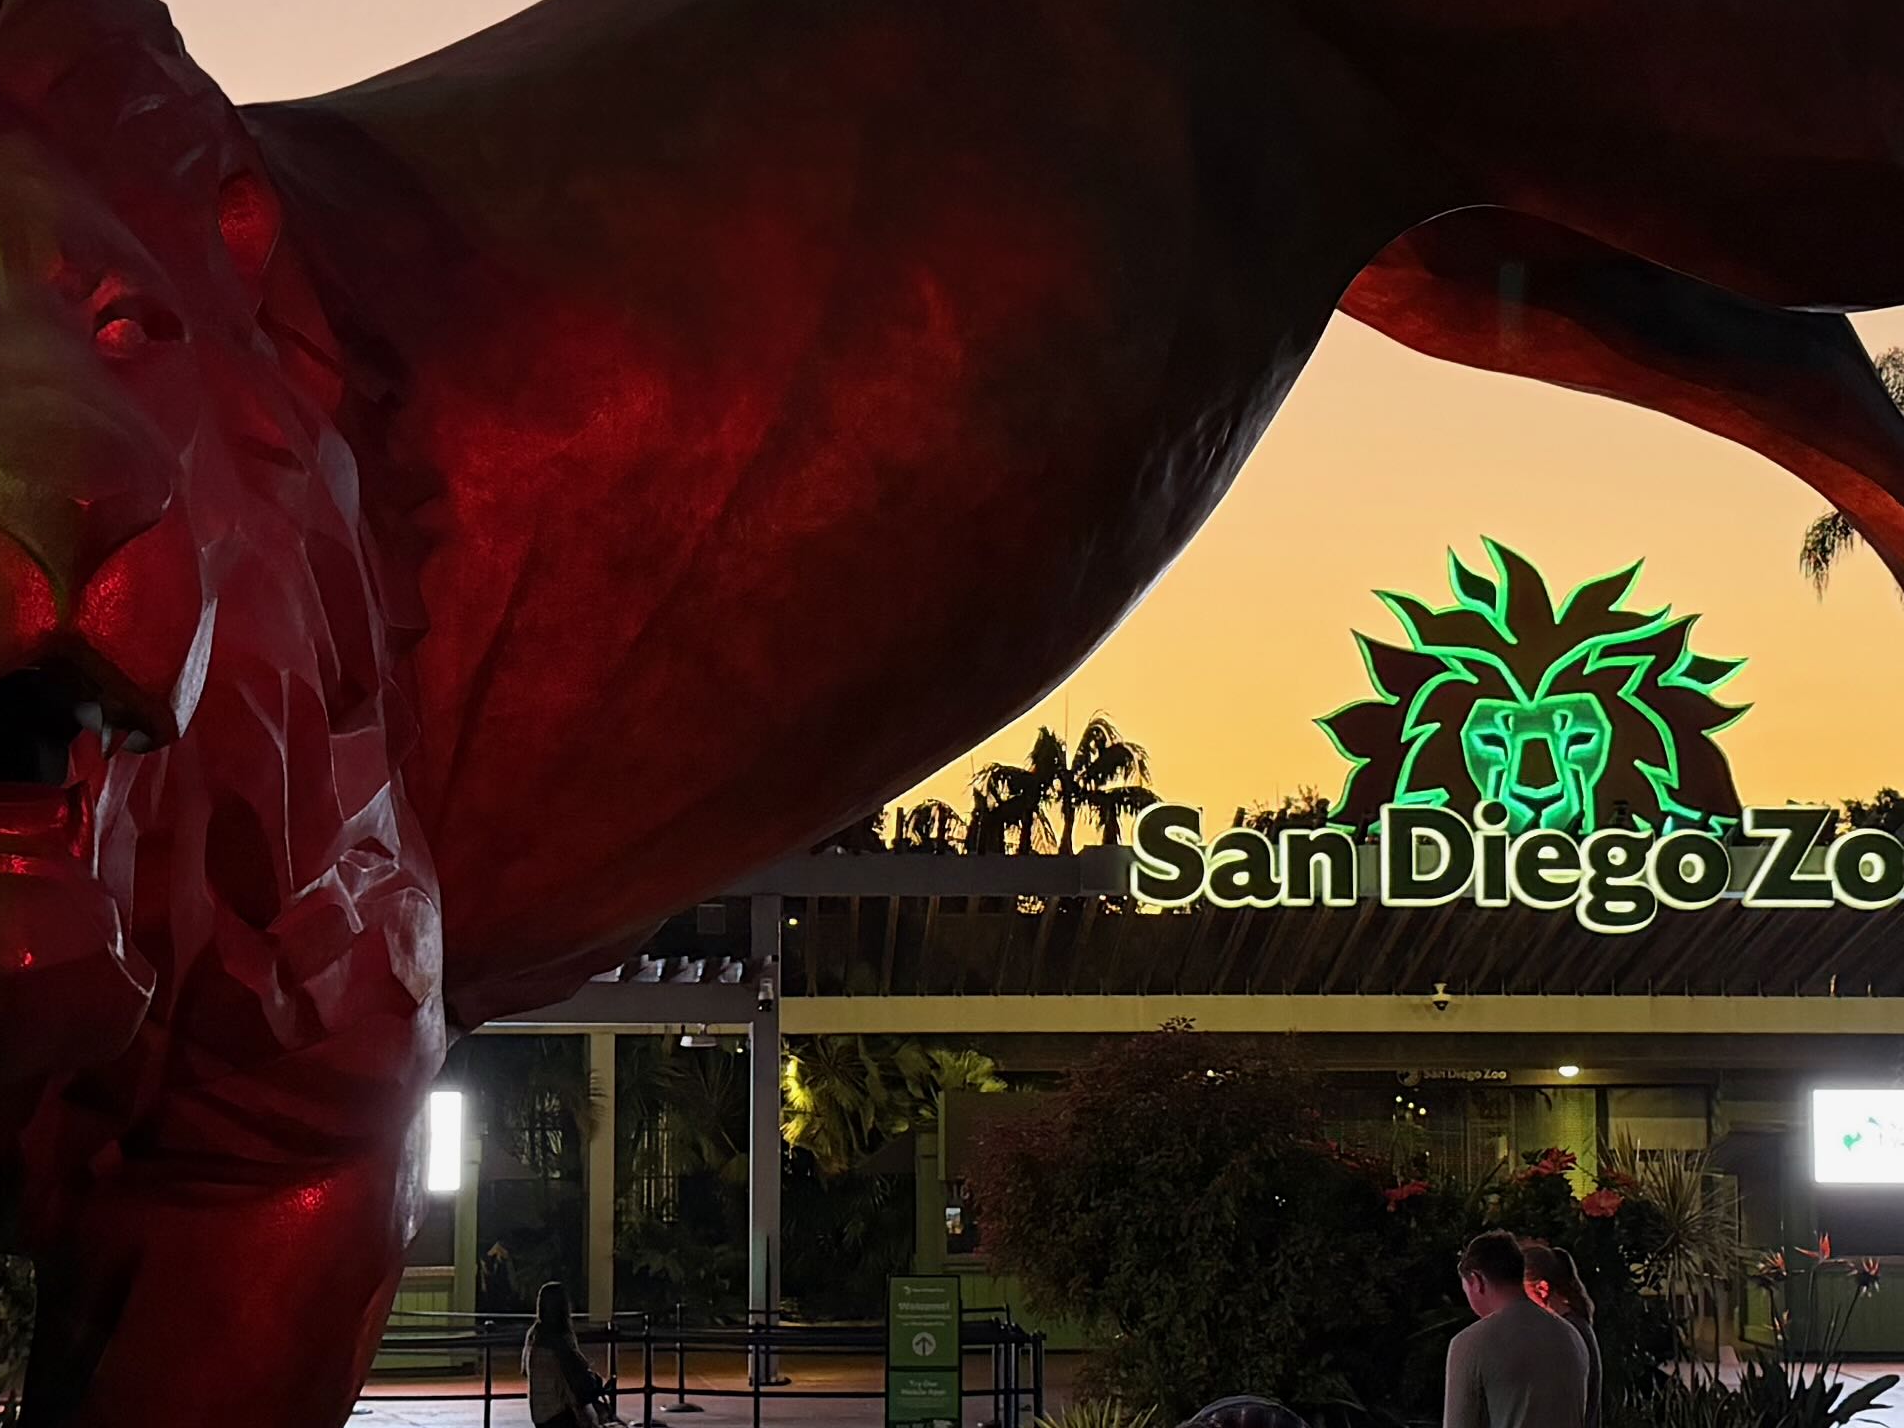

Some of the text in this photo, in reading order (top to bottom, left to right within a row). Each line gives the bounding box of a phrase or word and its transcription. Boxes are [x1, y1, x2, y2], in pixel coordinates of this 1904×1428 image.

[1130, 801, 1357, 908] San
[1380, 800, 1730, 933] Diego
[1484, 1068, 1507, 1080] Zoo
